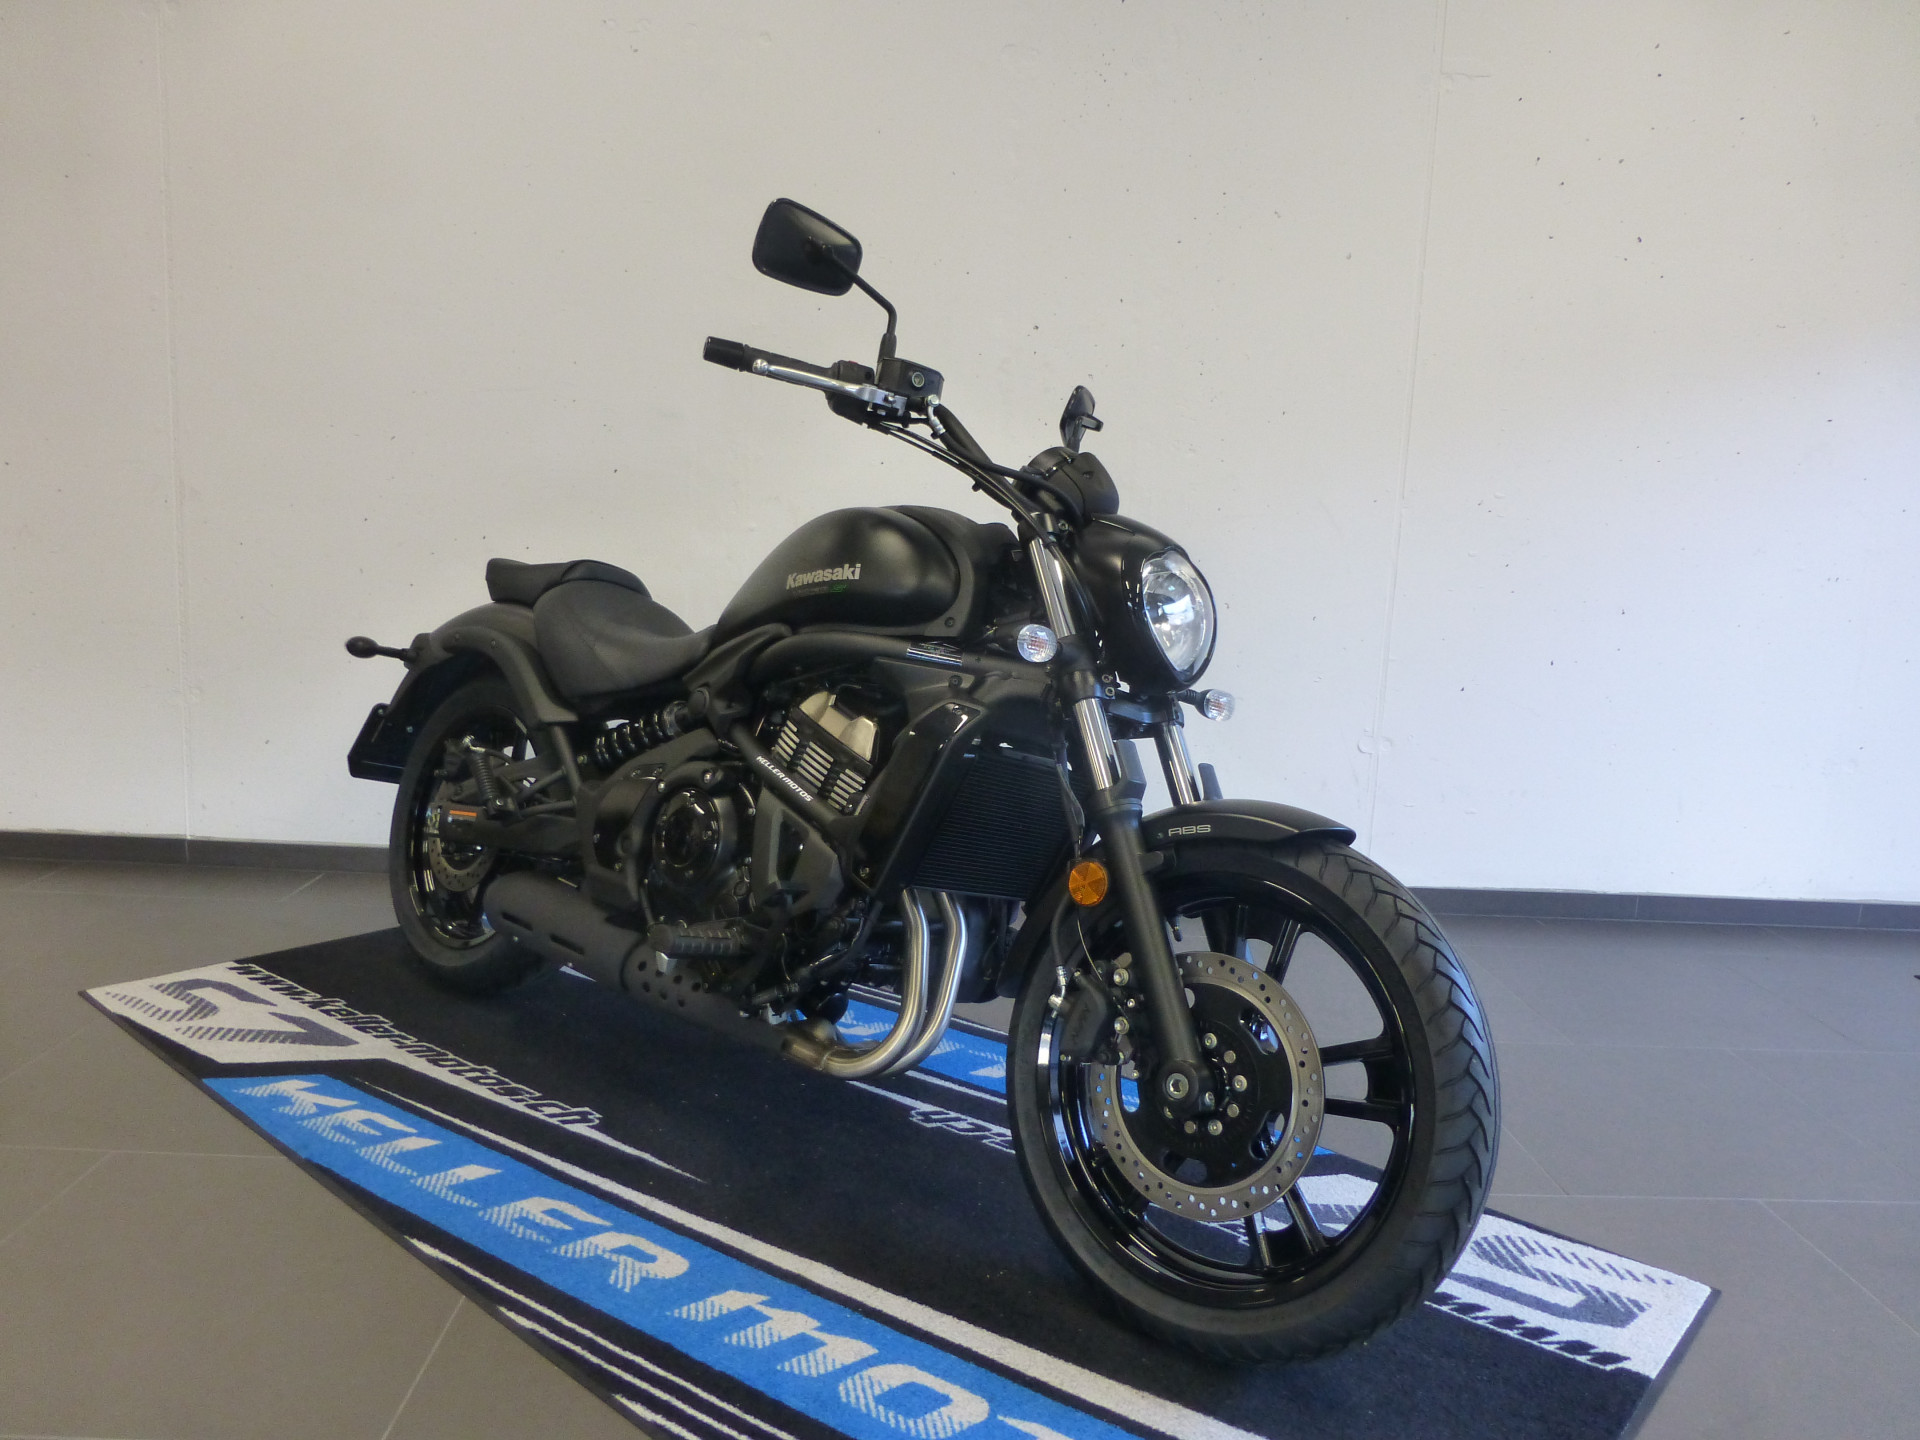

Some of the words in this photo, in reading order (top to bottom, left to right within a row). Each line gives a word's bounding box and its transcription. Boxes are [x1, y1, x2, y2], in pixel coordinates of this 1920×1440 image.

[786, 563, 862, 590] Kawasaki
[1168, 824, 1212, 837] ABS
[227, 963, 603, 1128] www.keller-motos.ch
[232, 1078, 690, 1293] KELLER
[664, 1289, 1076, 1440] MO
